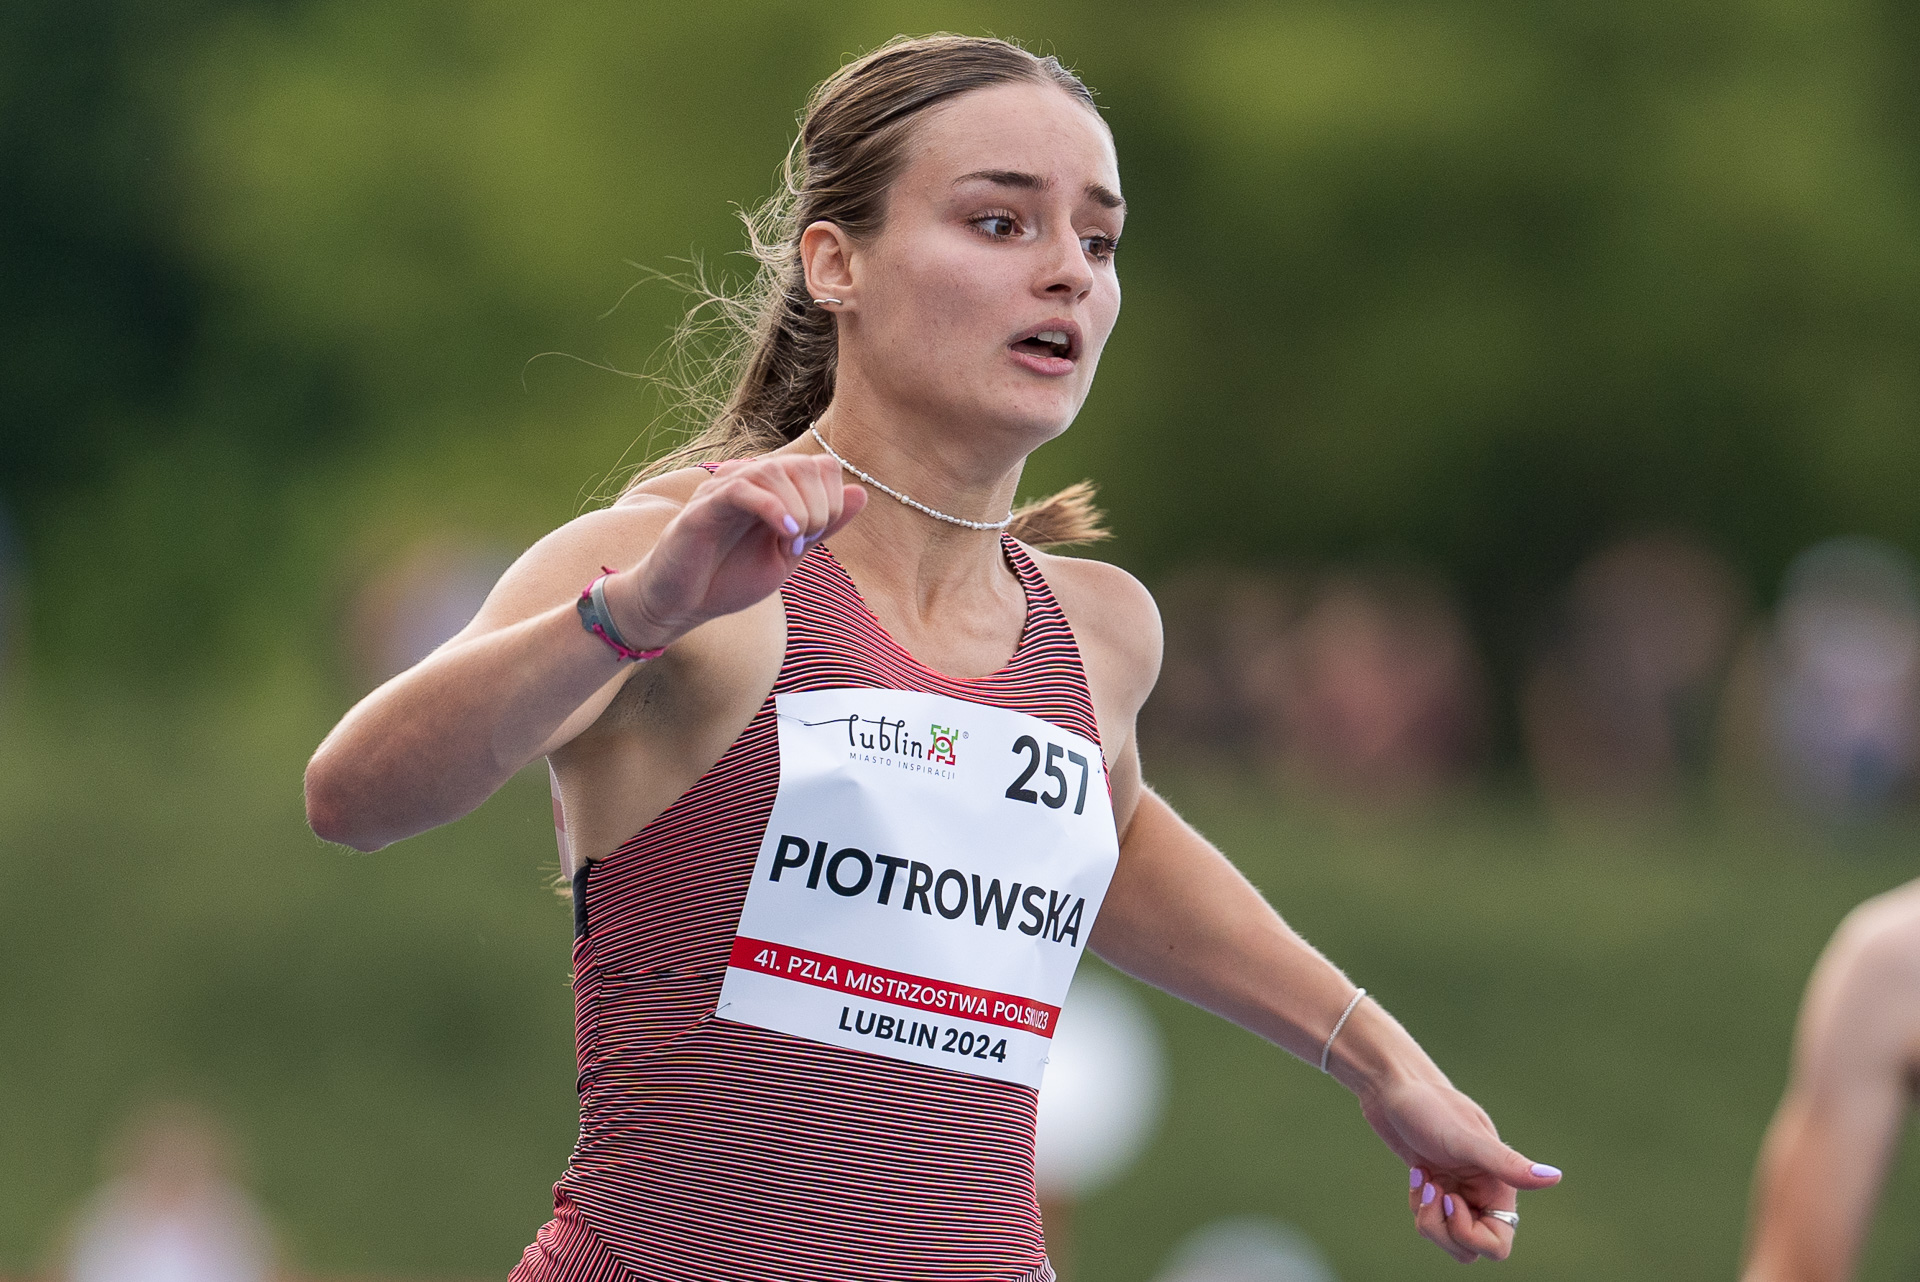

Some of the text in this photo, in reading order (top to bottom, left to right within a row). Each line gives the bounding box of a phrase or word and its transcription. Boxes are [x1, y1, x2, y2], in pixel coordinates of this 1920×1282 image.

[850, 752, 955, 780] MIASTO INSPIRACJI
[1005, 735, 1089, 815] 257
[769, 834, 1086, 948] PIOTROWSKA
[754, 949, 781, 971] 41.
[787, 956, 838, 985] PZLA
[844, 969, 988, 1018] MISTRZOSTWA
[838, 1006, 1007, 1063] LUBLIN 2024
